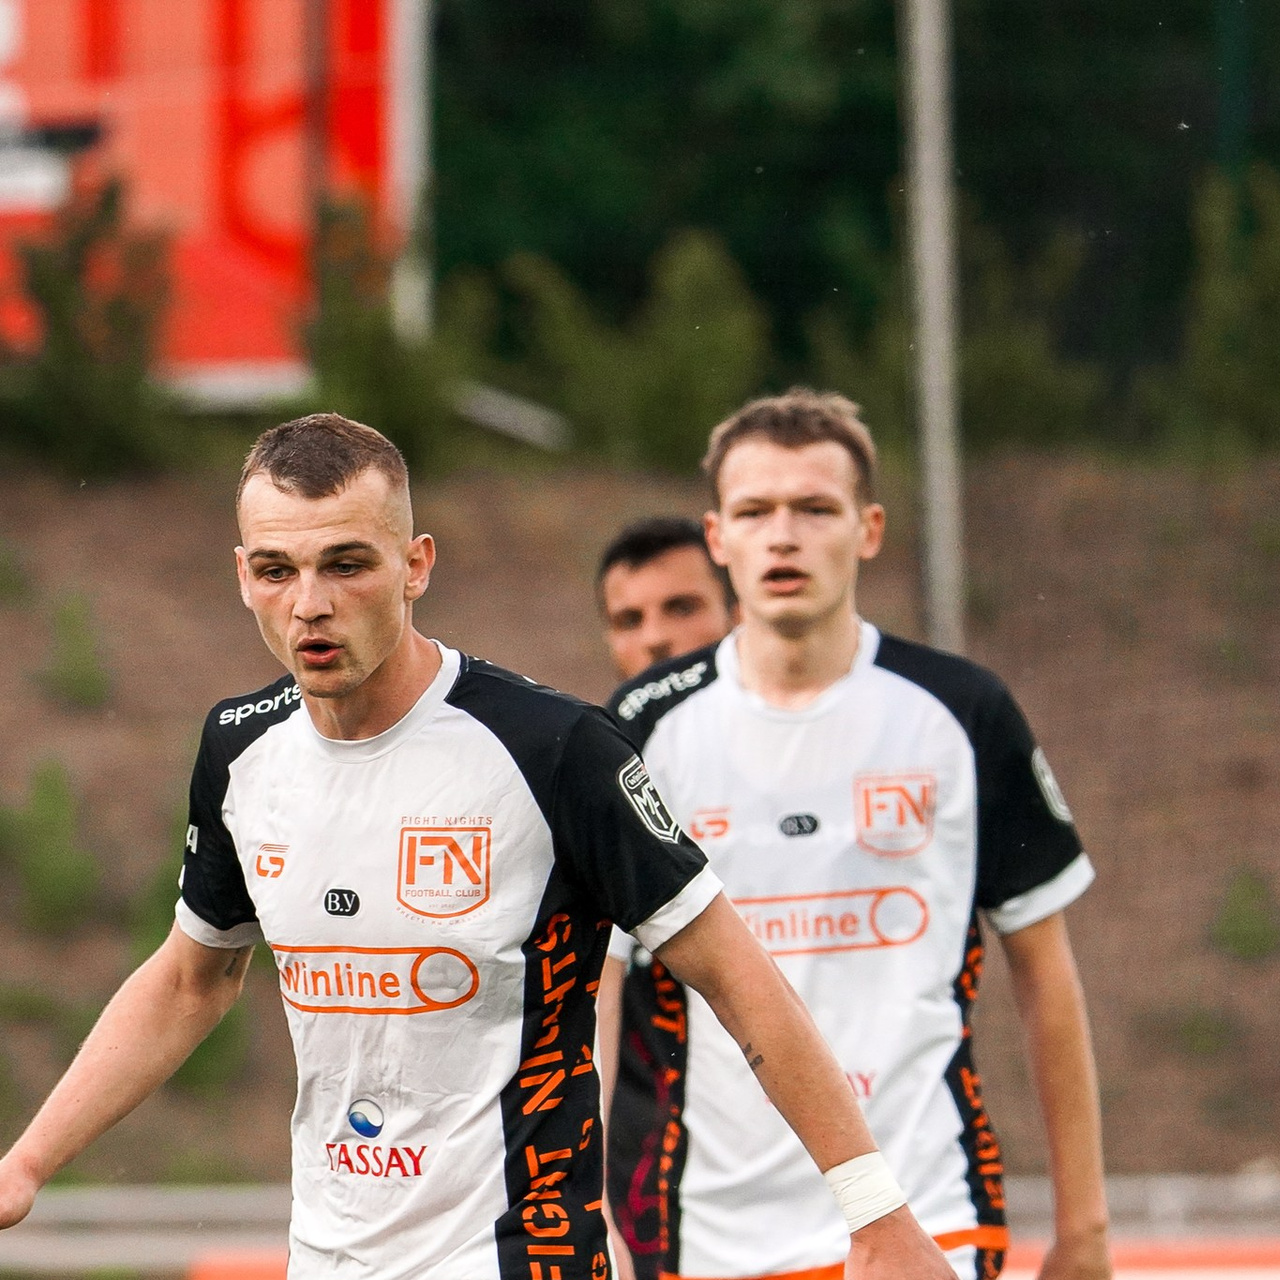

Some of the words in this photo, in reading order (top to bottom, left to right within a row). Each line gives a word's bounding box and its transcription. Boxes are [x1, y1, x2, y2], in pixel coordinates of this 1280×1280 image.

[219, 683, 302, 726] sports
[401, 816, 438, 825] FIGHT
[445, 816, 493, 825] NIGHTS
[405, 836, 483, 885] FN
[405, 889, 452, 898] FOOTBALL
[456, 889, 481, 898] CLUB
[281, 961, 401, 998] Winline
